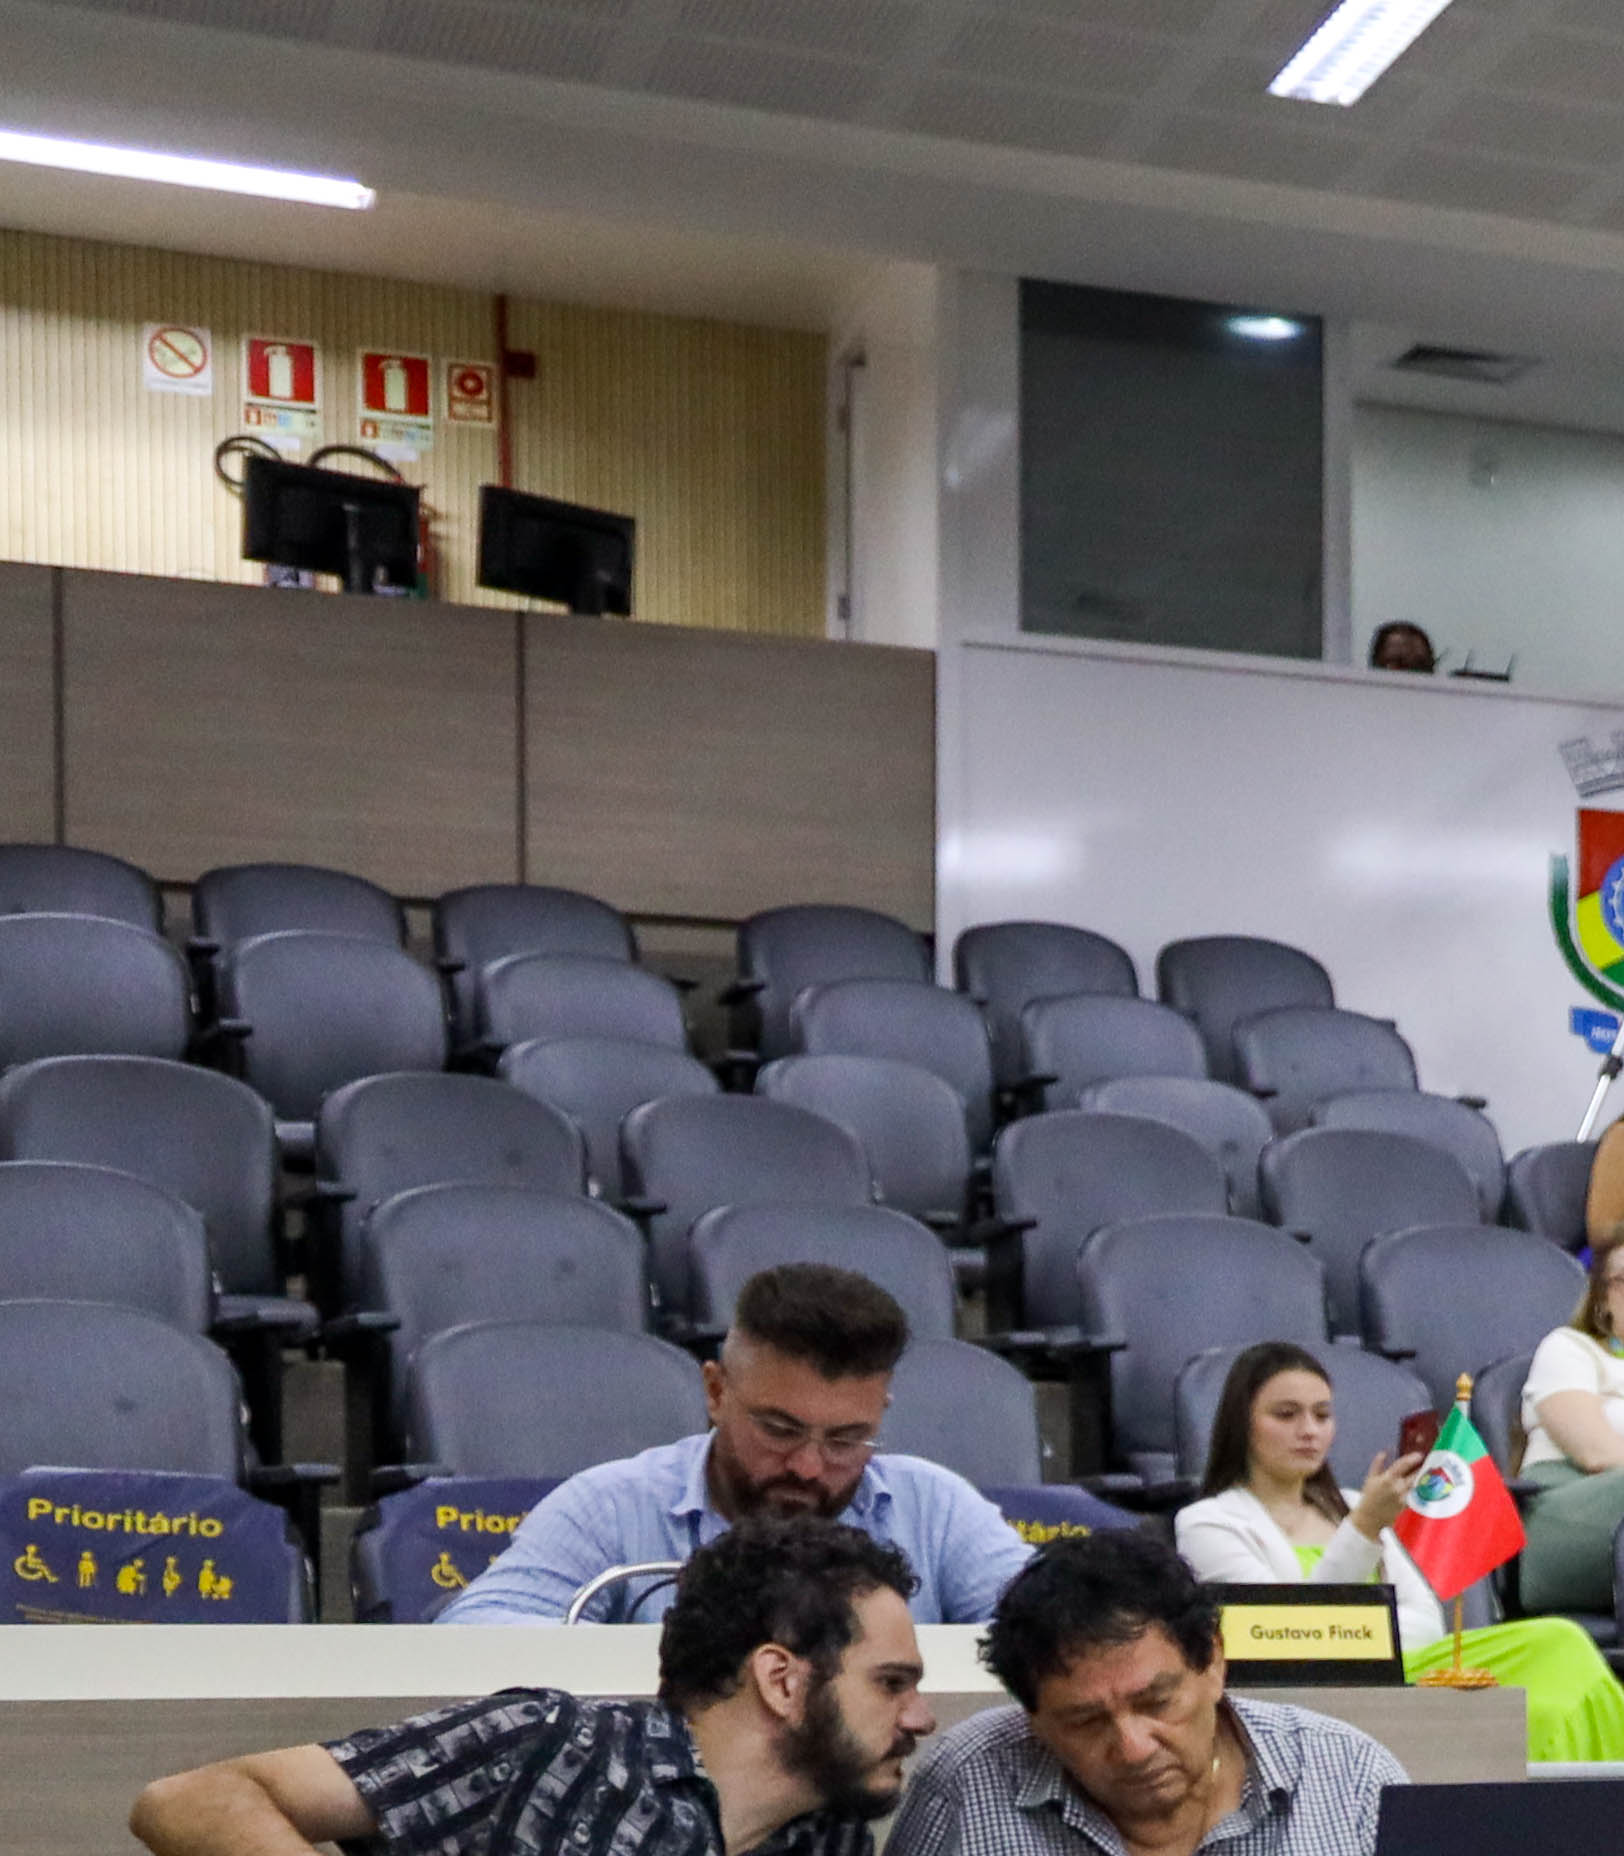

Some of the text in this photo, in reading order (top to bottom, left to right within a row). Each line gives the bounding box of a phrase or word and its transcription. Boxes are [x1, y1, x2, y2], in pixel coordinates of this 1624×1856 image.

[27, 1498, 224, 1538] Prioritário
[1250, 1624, 1373, 1640] Gustavo Finck
